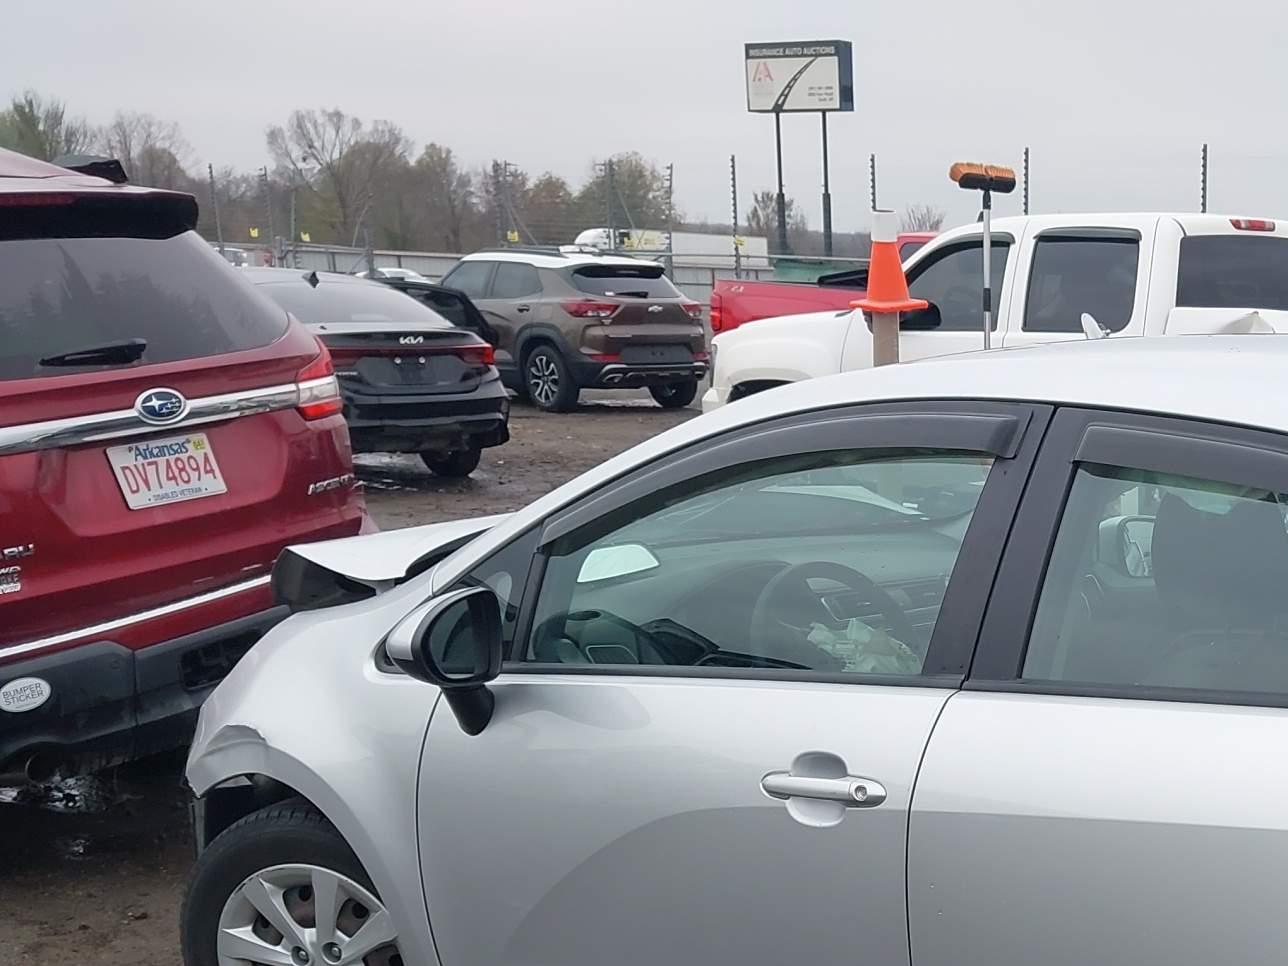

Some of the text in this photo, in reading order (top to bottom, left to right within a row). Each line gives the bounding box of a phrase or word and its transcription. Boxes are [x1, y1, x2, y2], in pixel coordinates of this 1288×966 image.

[785, 47, 802, 55] AUTO
[803, 46, 835, 54] AUCTIONS
[400, 336, 424, 344] KIA
[134, 441, 189, 462] Arkansas
[120, 452, 217, 495] DV74894
[179, 486, 203, 496] VETERAN
[2, 683, 41, 699] BUMPER
[5, 690, 45, 706] STICKER
